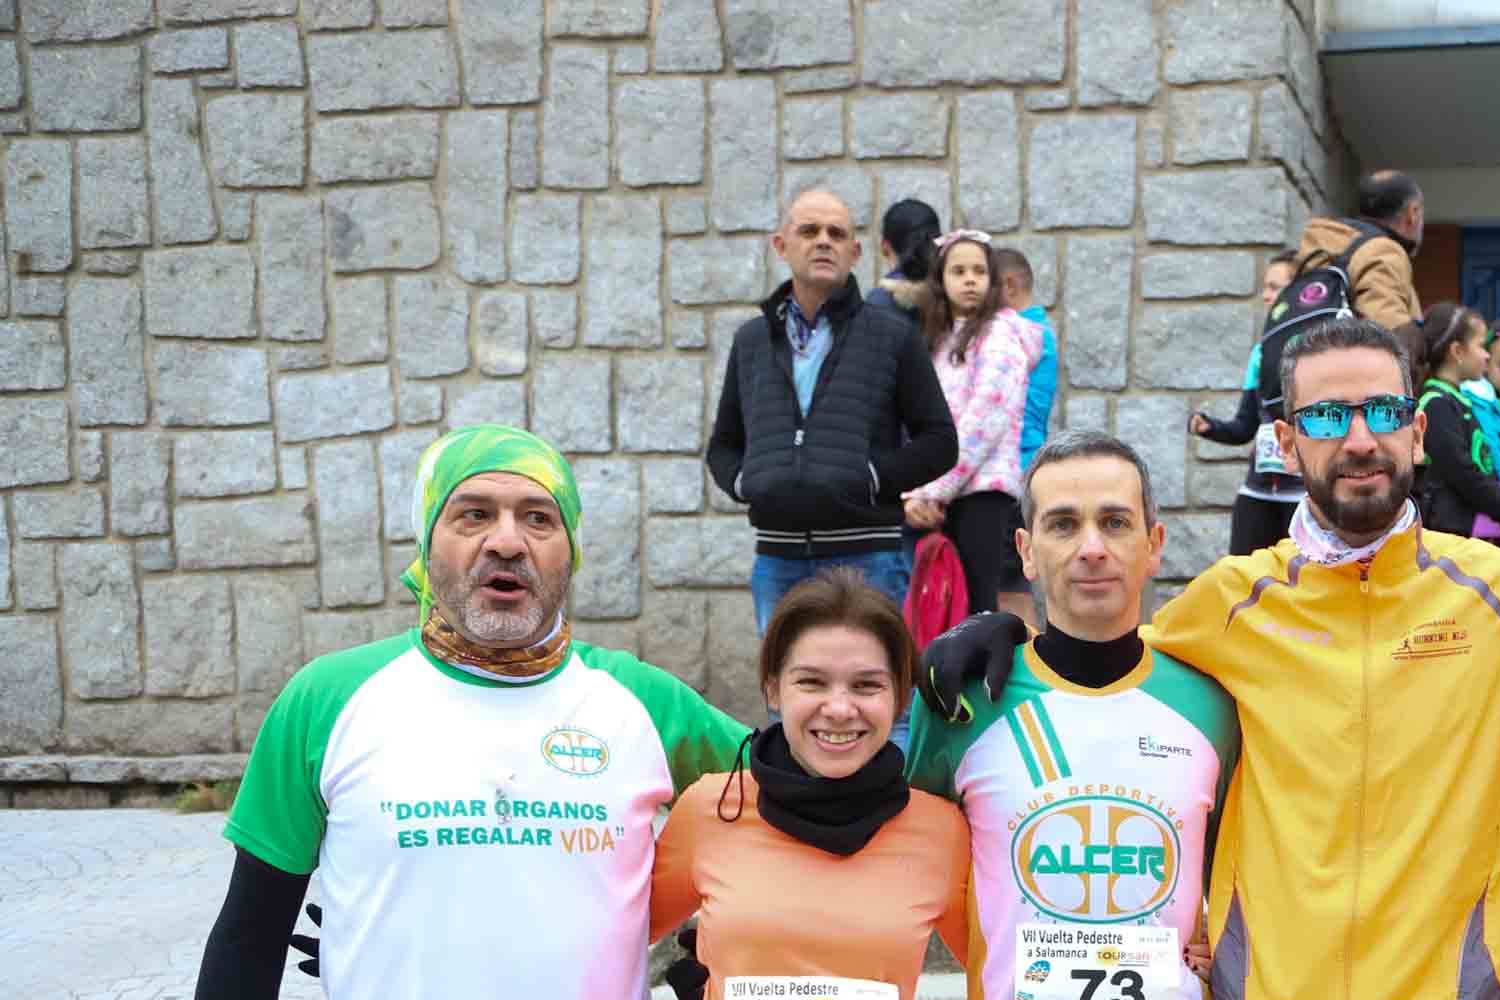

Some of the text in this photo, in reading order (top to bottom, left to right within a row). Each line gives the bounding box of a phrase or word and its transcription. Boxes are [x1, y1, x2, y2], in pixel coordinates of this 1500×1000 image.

[1007, 784, 1185, 831] CLUB DEPORTIVO
[397, 829, 429, 849] ES
[436, 827, 552, 846] REGALAR
[1029, 845, 1166, 882] ALCER
[1038, 929, 1073, 944] Vuelta
[1076, 930, 1123, 945] Pedestre
[1027, 946, 1088, 959] a Salamanca
[749, 982, 785, 996] Vuelta
[789, 982, 839, 996] Pedestre
